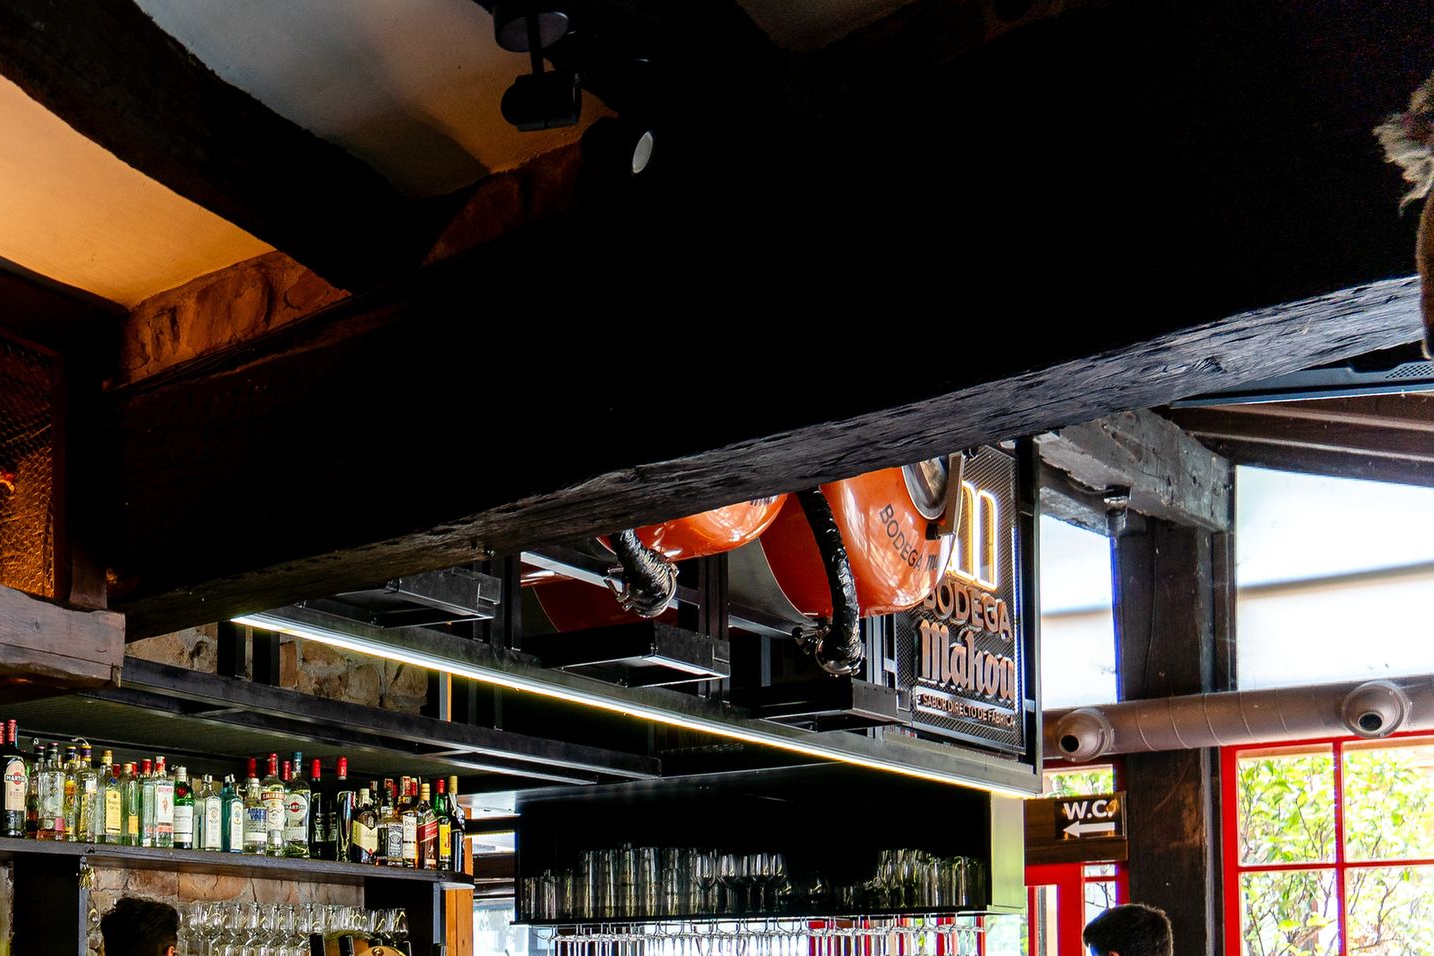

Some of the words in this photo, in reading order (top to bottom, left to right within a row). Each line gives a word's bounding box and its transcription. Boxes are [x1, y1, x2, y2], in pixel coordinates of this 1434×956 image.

[879, 503, 924, 572] BODEGA
[920, 618, 1015, 702] Mahou
[922, 693, 947, 710] SABOR
[947, 700, 977, 717] DIRECTO
[977, 707, 987, 720] DE
[1063, 799, 1113, 820] W.C.
